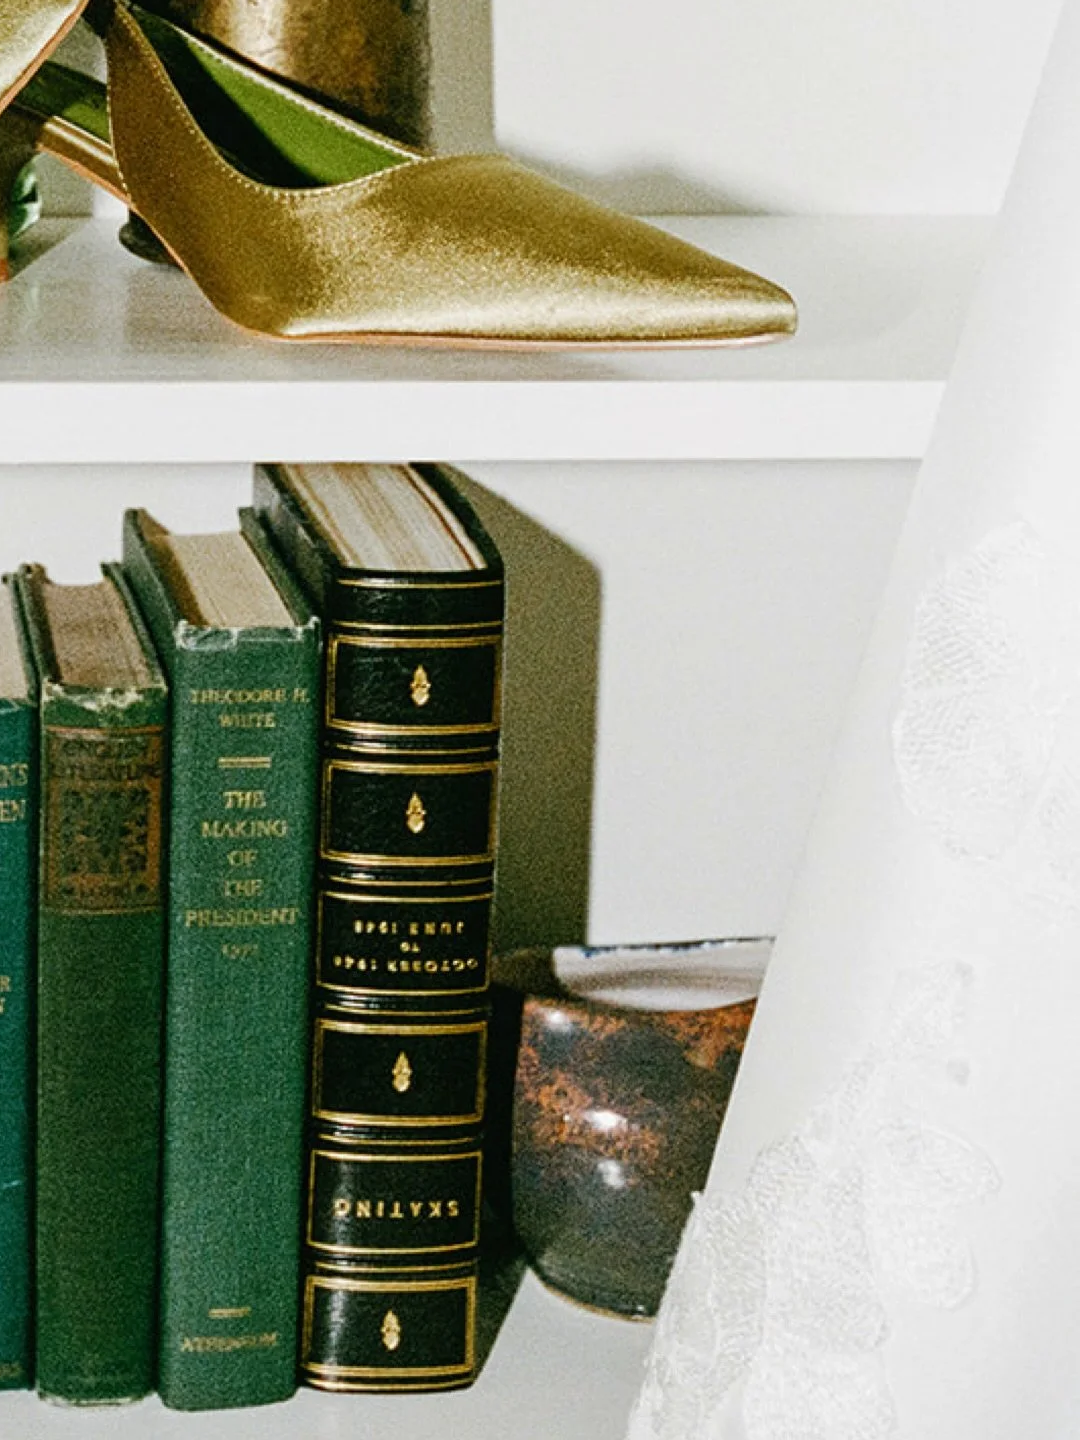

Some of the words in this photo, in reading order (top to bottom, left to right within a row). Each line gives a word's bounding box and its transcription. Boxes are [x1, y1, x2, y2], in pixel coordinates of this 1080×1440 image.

[222, 789, 266, 809] THE
[201, 819, 288, 838] MAKING
[226, 848, 258, 867] OF
[185, 907, 300, 928] PRESIDENT
[405, 919, 466, 936] JUNE
[399, 940, 421, 953] TO
[387, 958, 479, 974] OCTOBER
[333, 1198, 460, 1218] SKATING
